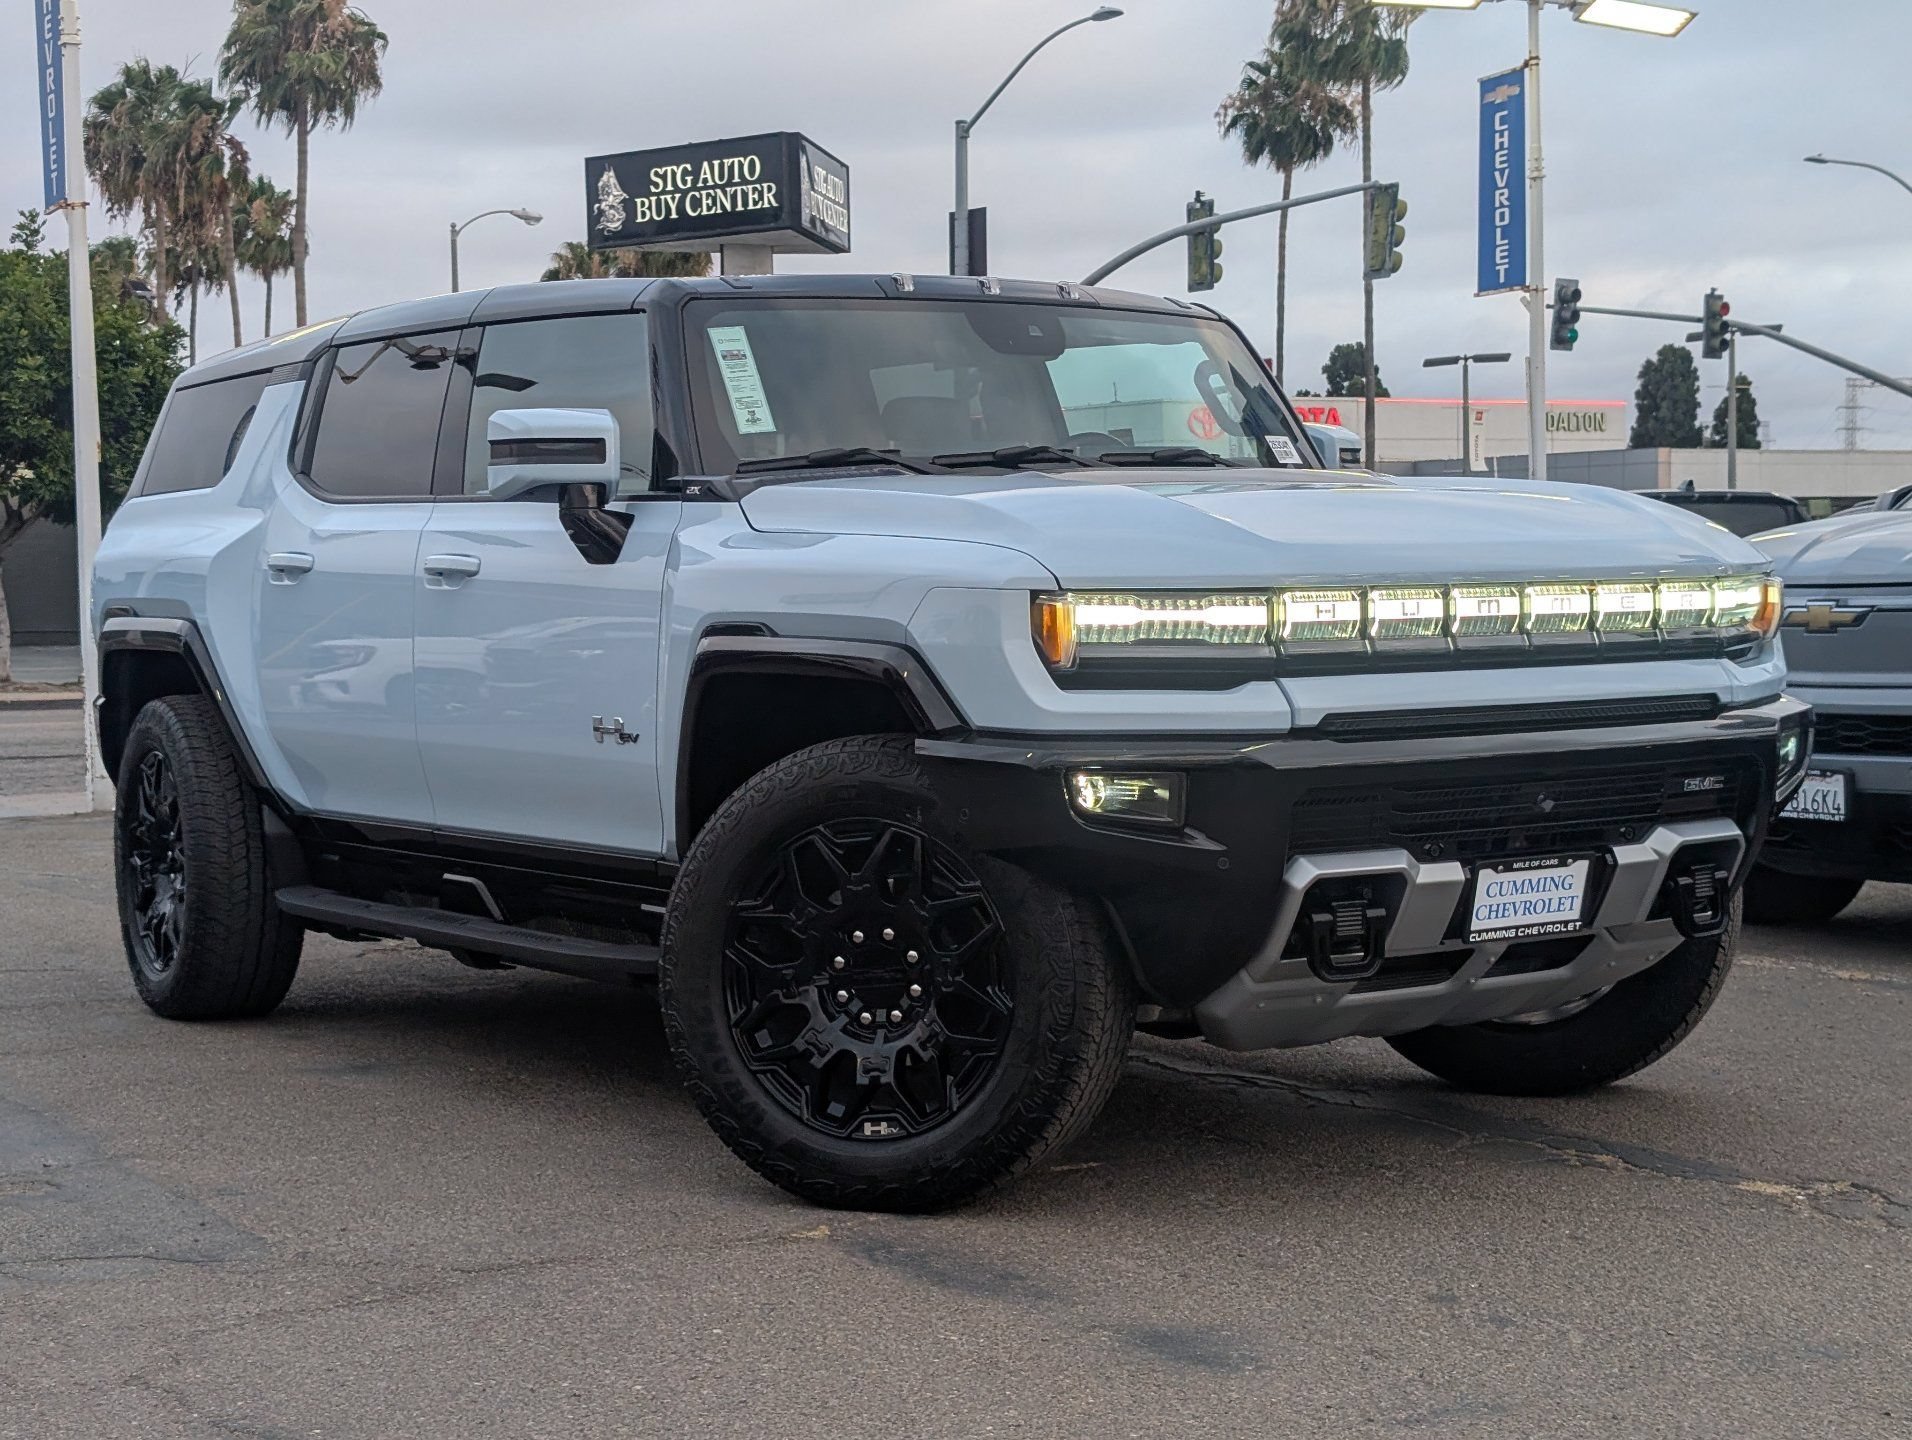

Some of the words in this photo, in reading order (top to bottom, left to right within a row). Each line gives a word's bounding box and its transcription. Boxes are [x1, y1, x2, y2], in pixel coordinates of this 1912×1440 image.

[650, 164, 694, 193] STG
[697, 155, 761, 187] AUTO
[634, 194, 682, 223] BUY
[685, 182, 779, 217] CENTER
[1494, 110, 1510, 283] CHEVROLET
[1545, 412, 1606, 432] DALTON
[1684, 776, 1724, 791] GMC
[1800, 813, 1845, 821] CHEVROLET
[1541, 858, 1559, 867] CARS
[1485, 874, 1574, 899] CUMMING
[1475, 895, 1579, 921] CHEVROLET
[1469, 928, 1516, 942] CUMMING
[1517, 921, 1582, 936] CHEVROLET
